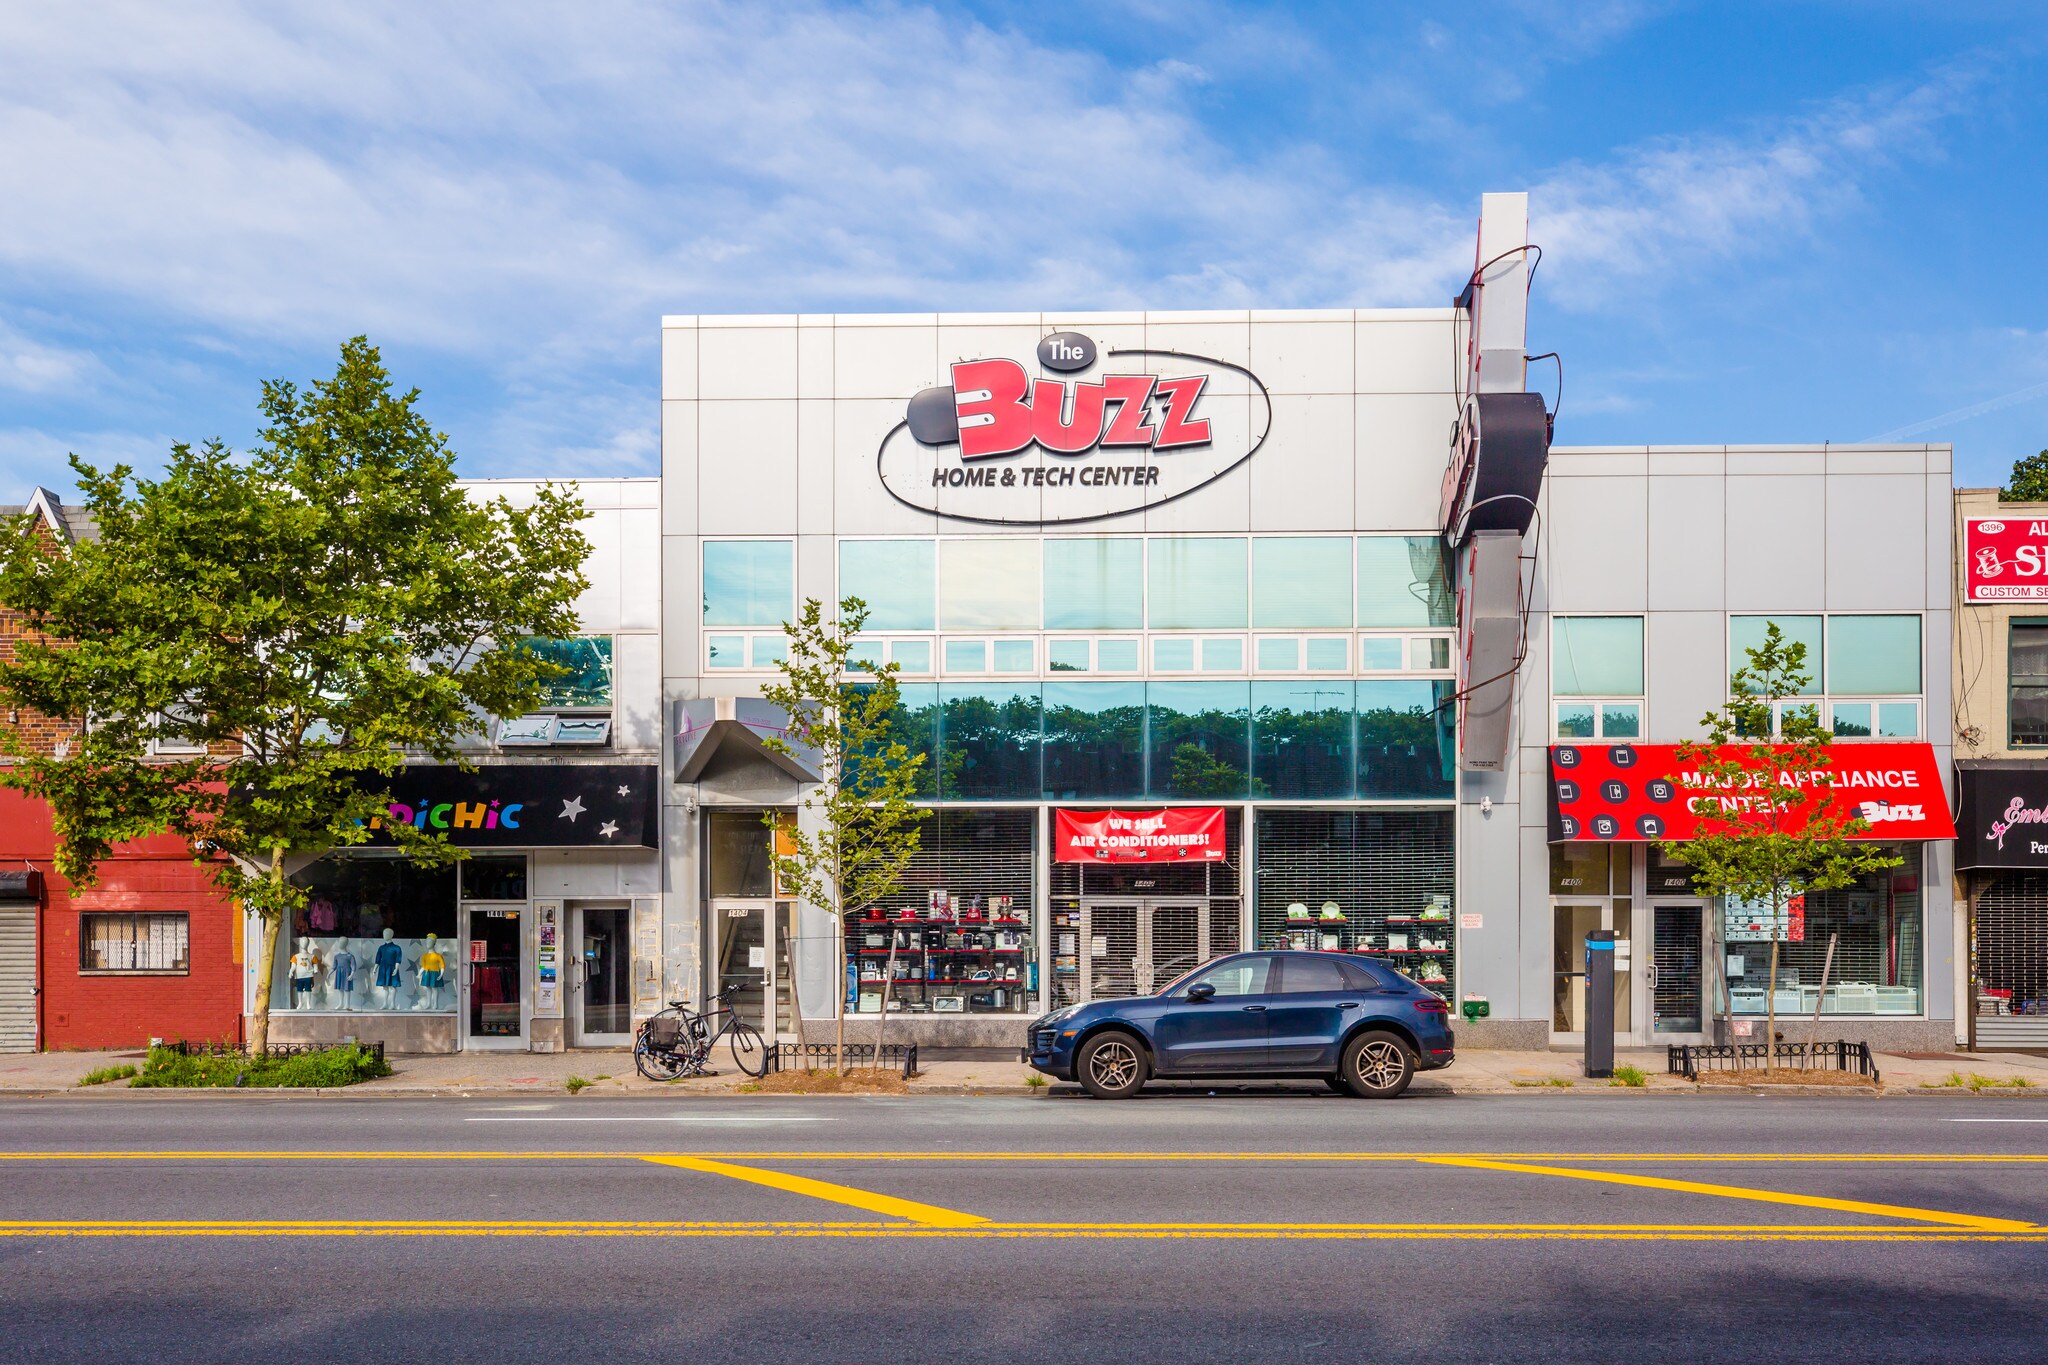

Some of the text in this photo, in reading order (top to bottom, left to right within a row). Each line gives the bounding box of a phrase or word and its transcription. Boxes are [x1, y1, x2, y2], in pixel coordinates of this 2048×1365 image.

[1048, 339, 1084, 361] The
[931, 466, 1160, 487] HOME & TECH CENTER
[1980, 523, 2003, 532] 1396
[1980, 586, 2031, 597] CUSTOM
[1778, 770, 1920, 789] APPLIANCE
[1108, 817, 1167, 830] WE SELL
[1070, 833, 1210, 848] AIR CONDITIONERS!
[1560, 878, 1582, 886] 1400
[1664, 878, 1686, 886] 1400
